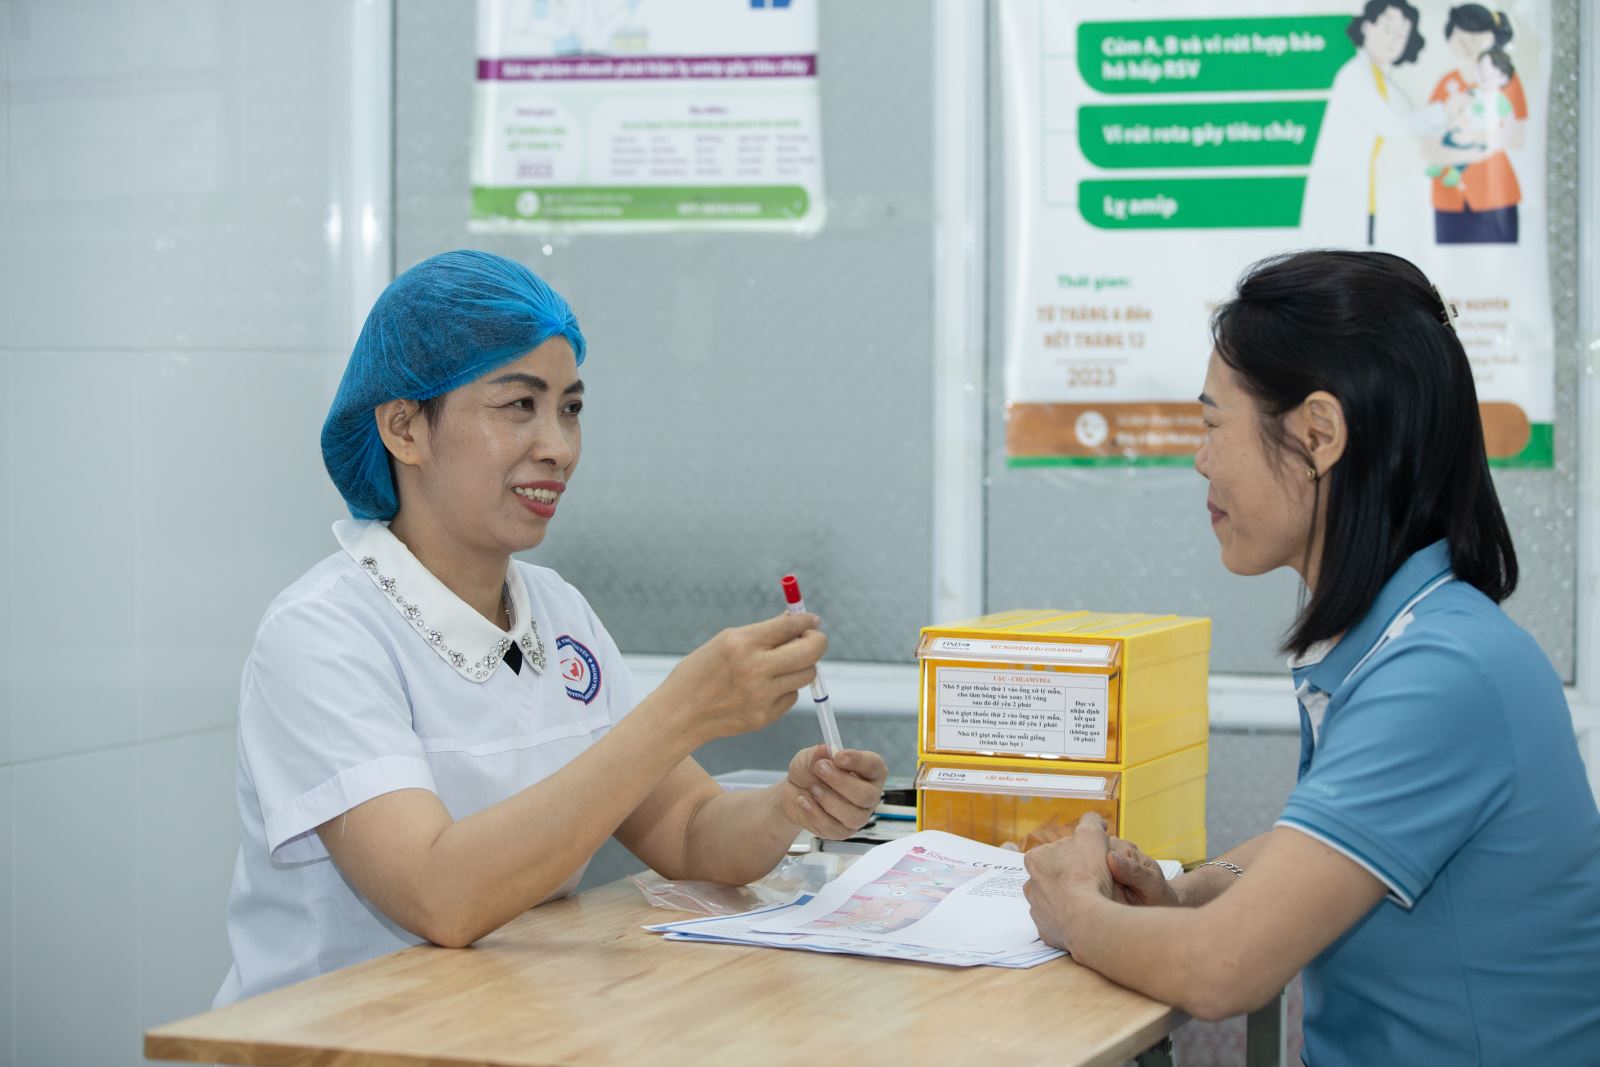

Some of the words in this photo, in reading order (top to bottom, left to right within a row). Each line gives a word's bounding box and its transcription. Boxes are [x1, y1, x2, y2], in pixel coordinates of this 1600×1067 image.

[1164, 34, 1179, 55] B
[1163, 58, 1201, 80] RSV
[1152, 124, 1190, 144] rota
[1191, 122, 1225, 147] gây
[1226, 121, 1262, 142] tiêu
[1066, 366, 1117, 387] 2023
